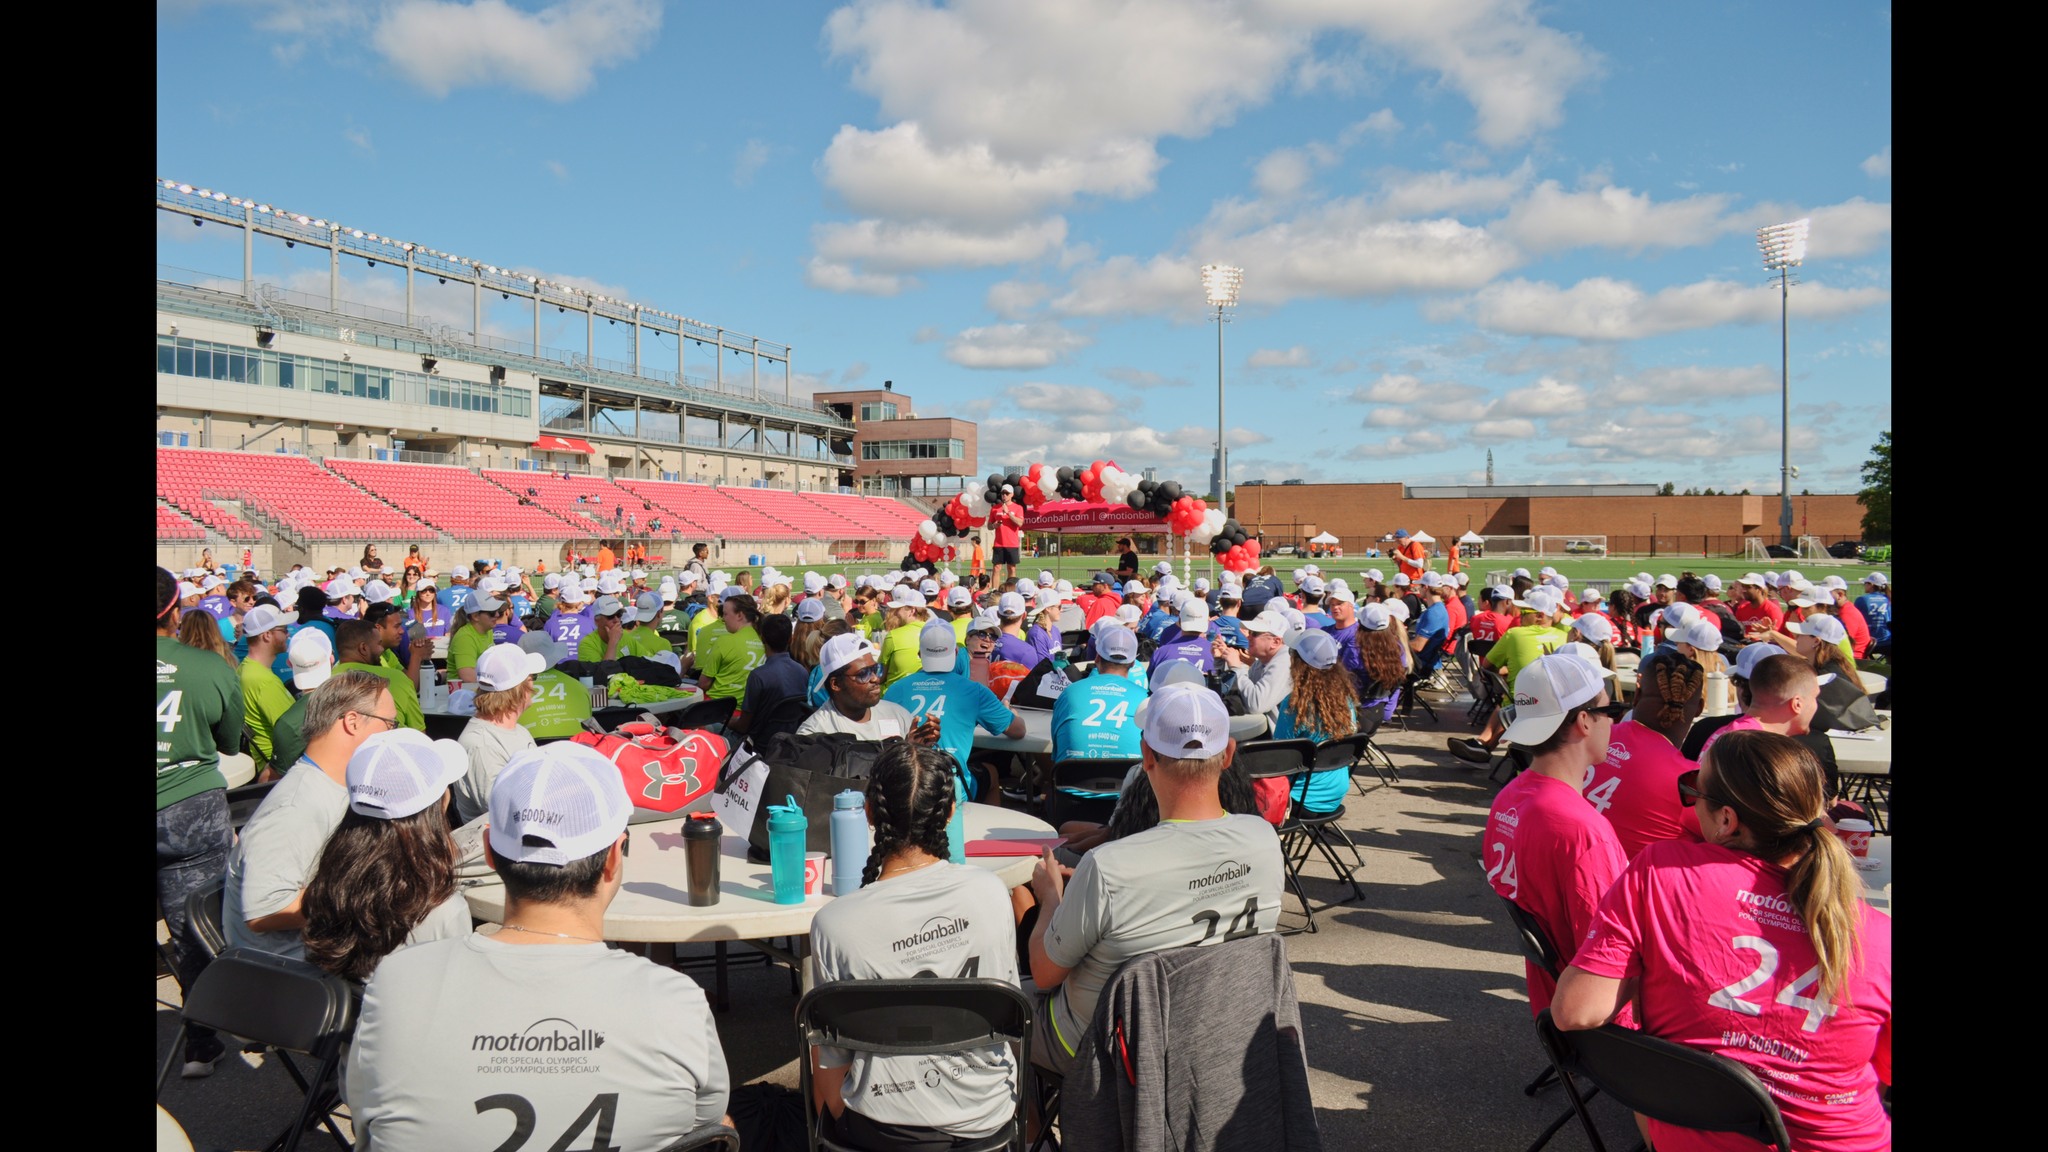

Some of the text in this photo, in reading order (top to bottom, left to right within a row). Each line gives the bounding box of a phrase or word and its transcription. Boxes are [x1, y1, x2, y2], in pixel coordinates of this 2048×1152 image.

[1023, 512, 1089, 525] motionball.com
[1098, 511, 1155, 521] @motionball
[1868, 603, 1888, 615] 24
[557, 625, 581, 641] 24
[531, 682, 567, 703] 24
[157, 690, 183, 732] 4
[910, 694, 947, 722] 24
[1081, 698, 1130, 729] 24
[738, 778, 749, 793] 53
[724, 798, 730, 808] 3
[726, 787, 750, 811] ANCIAL
[521, 808, 545, 823] GOOD
[546, 811, 565, 826] WAY
[1188, 863, 1246, 890] motionball
[1486, 842, 1518, 899] 24
[1735, 889, 1798, 915] motion
[1191, 896, 1259, 947] 24
[1738, 911, 1757, 922] POUR
[1757, 916, 1801, 932] OLYMPIQUES
[1749, 907, 1763, 916] FOR
[1764, 911, 1790, 923] SPECIAL
[892, 917, 963, 953] motionball
[1707, 935, 1839, 1033] 24
[471, 1029, 593, 1052] motionball
[1721, 1031, 1809, 1065] #NO GOOD WAY
[477, 1064, 600, 1074] POUR OLYMPIQUES SPÉCIAUX
[490, 1056, 588, 1065] FOR SPECIAL OLYMPICS
[1758, 1067, 1800, 1082] SPONSORS
[1826, 1096, 1854, 1105] GROUP
[473, 1092, 622, 1152] 24
